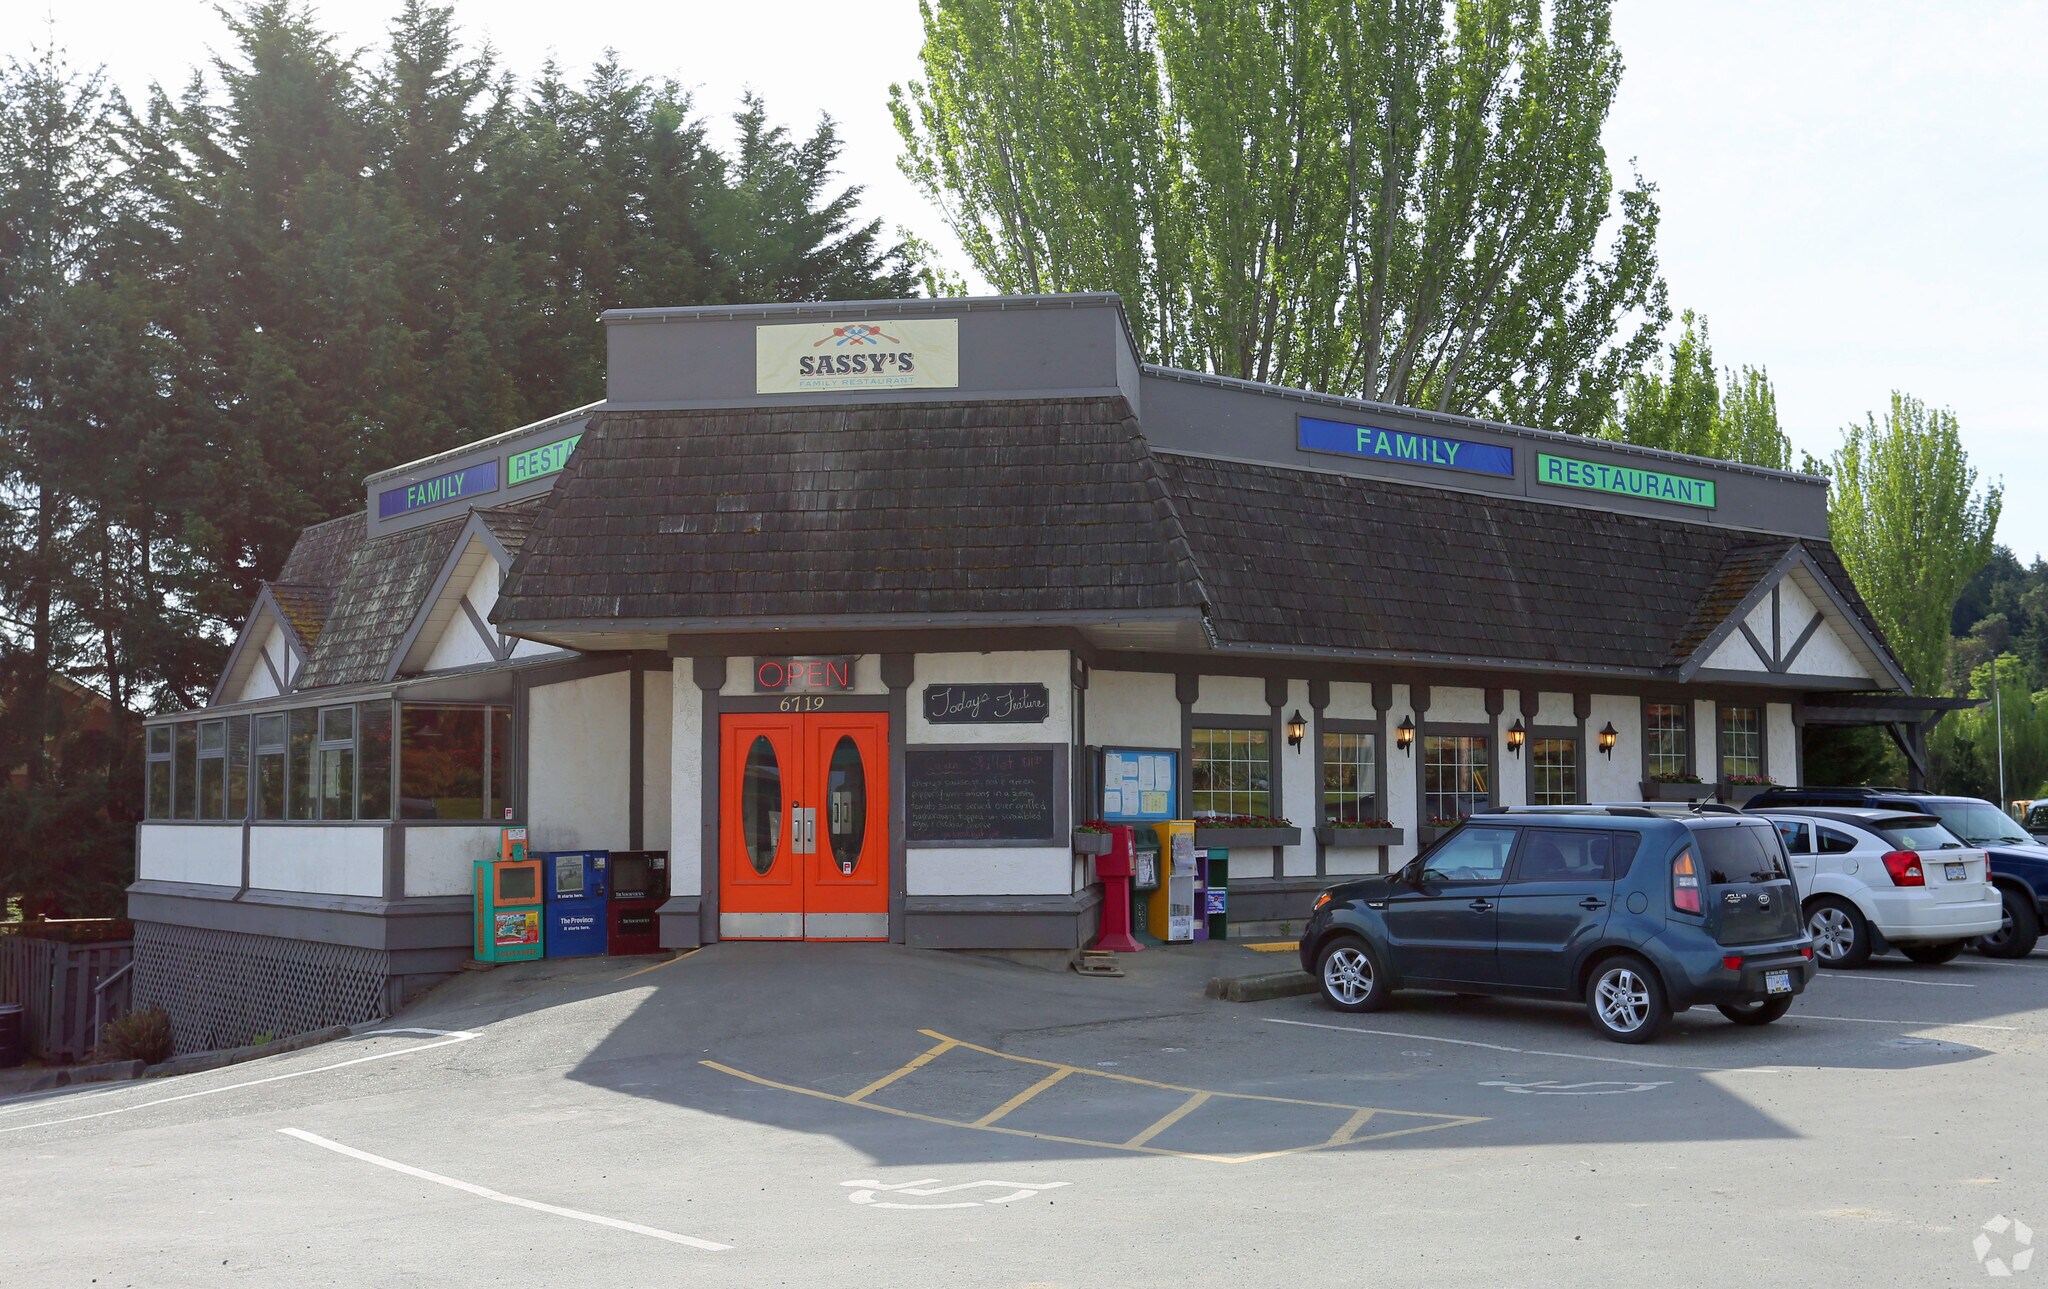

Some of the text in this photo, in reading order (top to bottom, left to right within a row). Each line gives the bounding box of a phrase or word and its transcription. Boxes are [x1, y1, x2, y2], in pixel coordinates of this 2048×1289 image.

[800, 352, 914, 376] SASSY'S
[800, 377, 914, 387] FAMILY RESTAURANT
[1356, 428, 1707, 504] FAMILY RESTAURANT
[406, 472, 465, 509] FAMILY
[758, 661, 849, 687] OPEN
[779, 696, 825, 712] 6719
[994, 689, 1045, 718] Feature
[571, 916, 594, 924] Province
